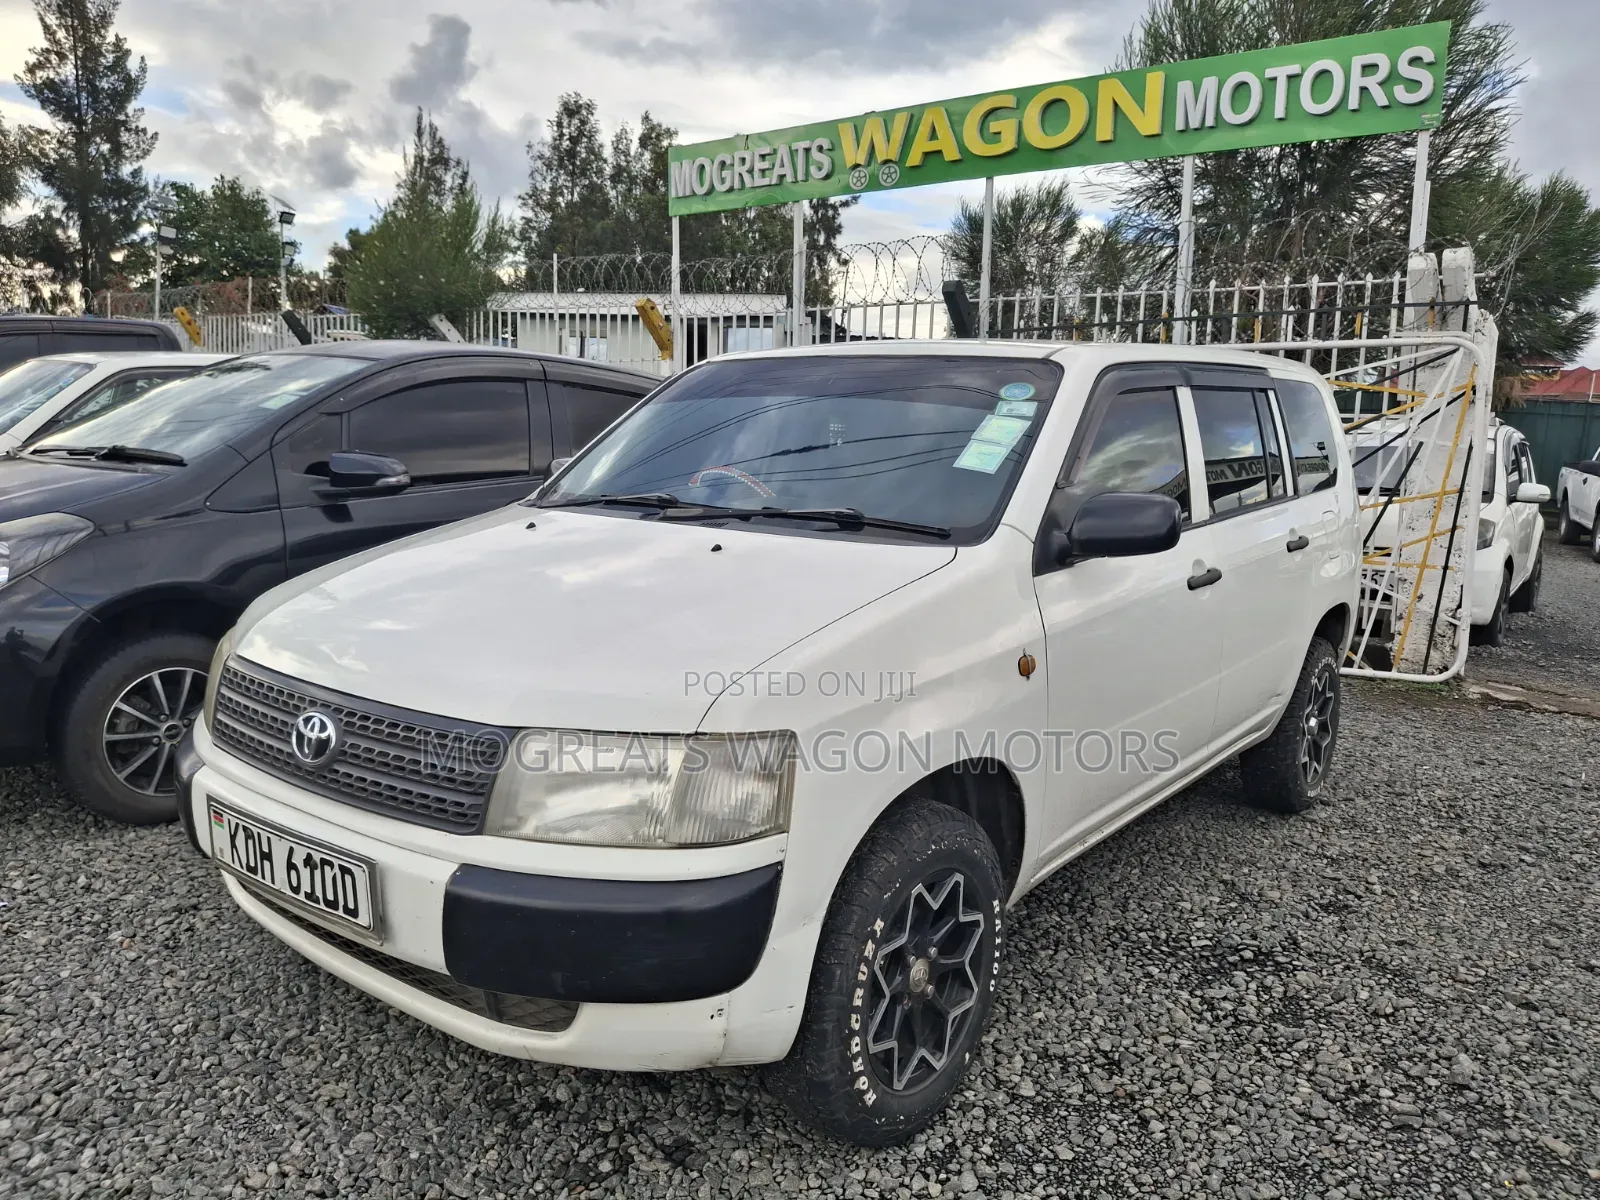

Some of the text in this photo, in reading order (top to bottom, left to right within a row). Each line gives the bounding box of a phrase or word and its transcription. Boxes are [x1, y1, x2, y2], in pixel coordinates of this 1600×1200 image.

[669, 45, 1437, 199] MOGREATS WAGON MOTORS
[227, 817, 359, 920] KDH 610D
[850, 917, 885, 1108] ROADCRUZA
